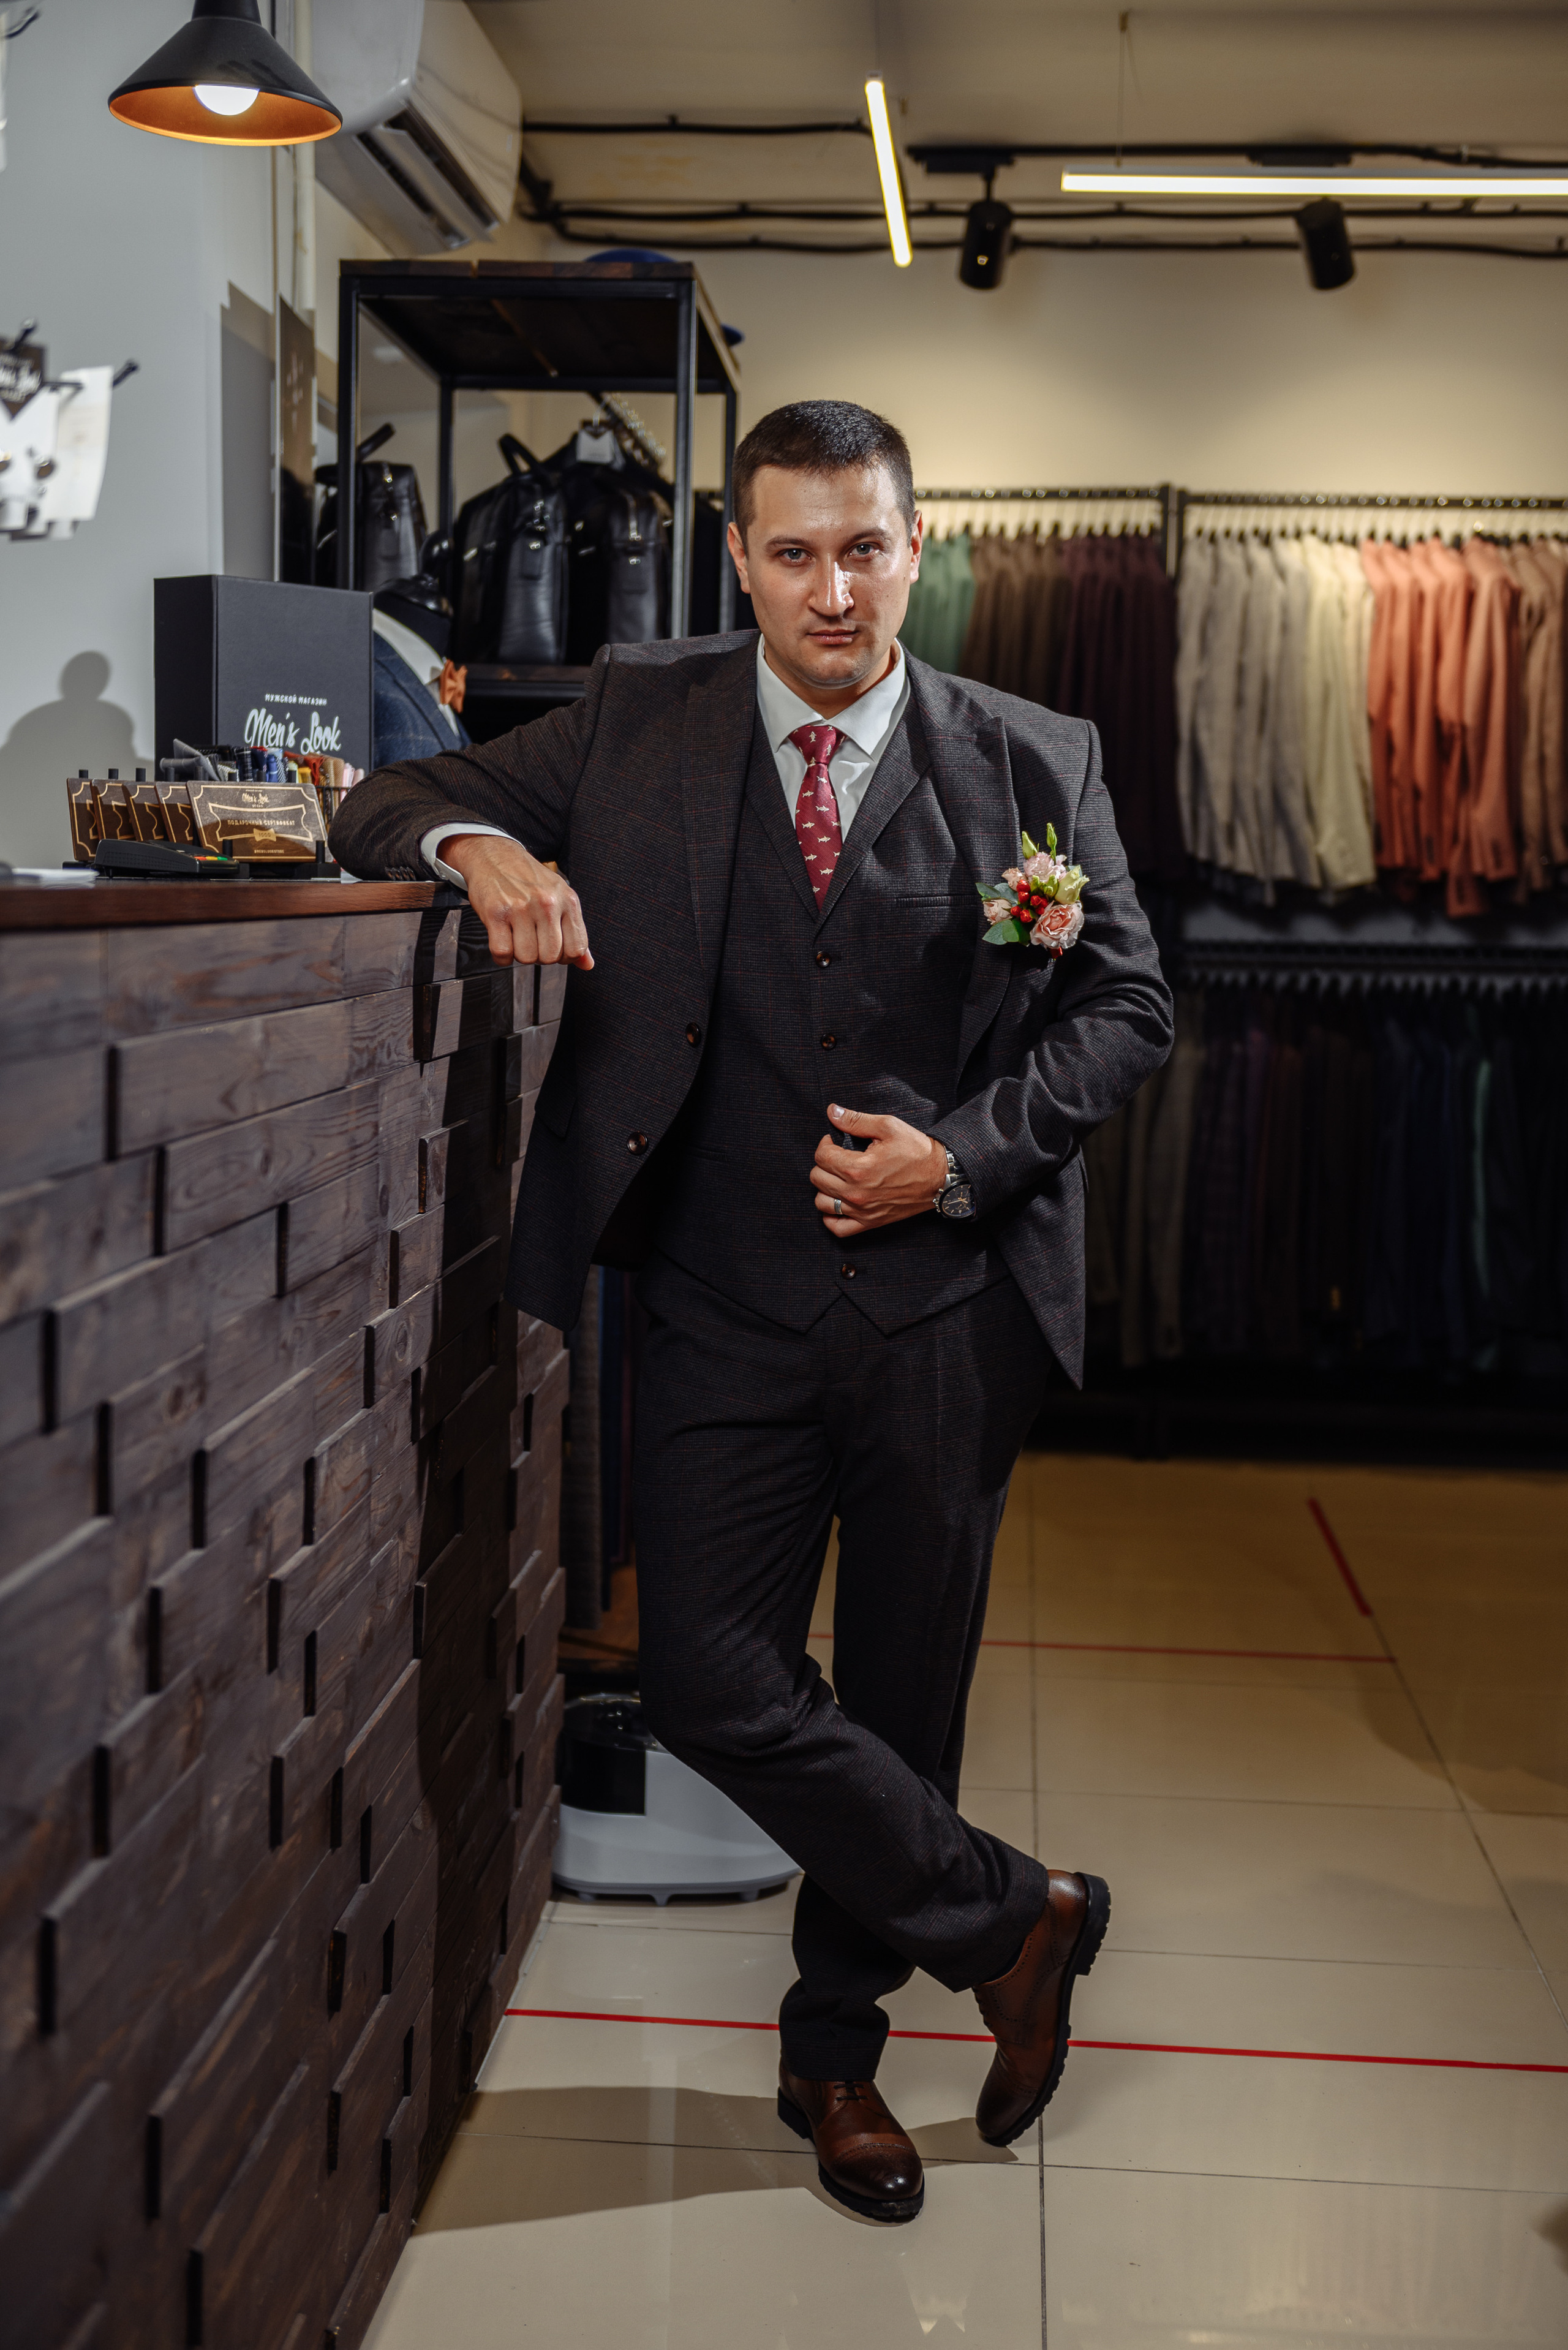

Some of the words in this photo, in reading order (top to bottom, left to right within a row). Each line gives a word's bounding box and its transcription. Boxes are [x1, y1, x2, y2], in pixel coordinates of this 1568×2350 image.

[265, 693, 297, 704] МУЖСКОЙ
[298, 696, 328, 706] МАГАЗИН
[244, 708, 301, 749] Men's
[300, 711, 342, 755] Look
